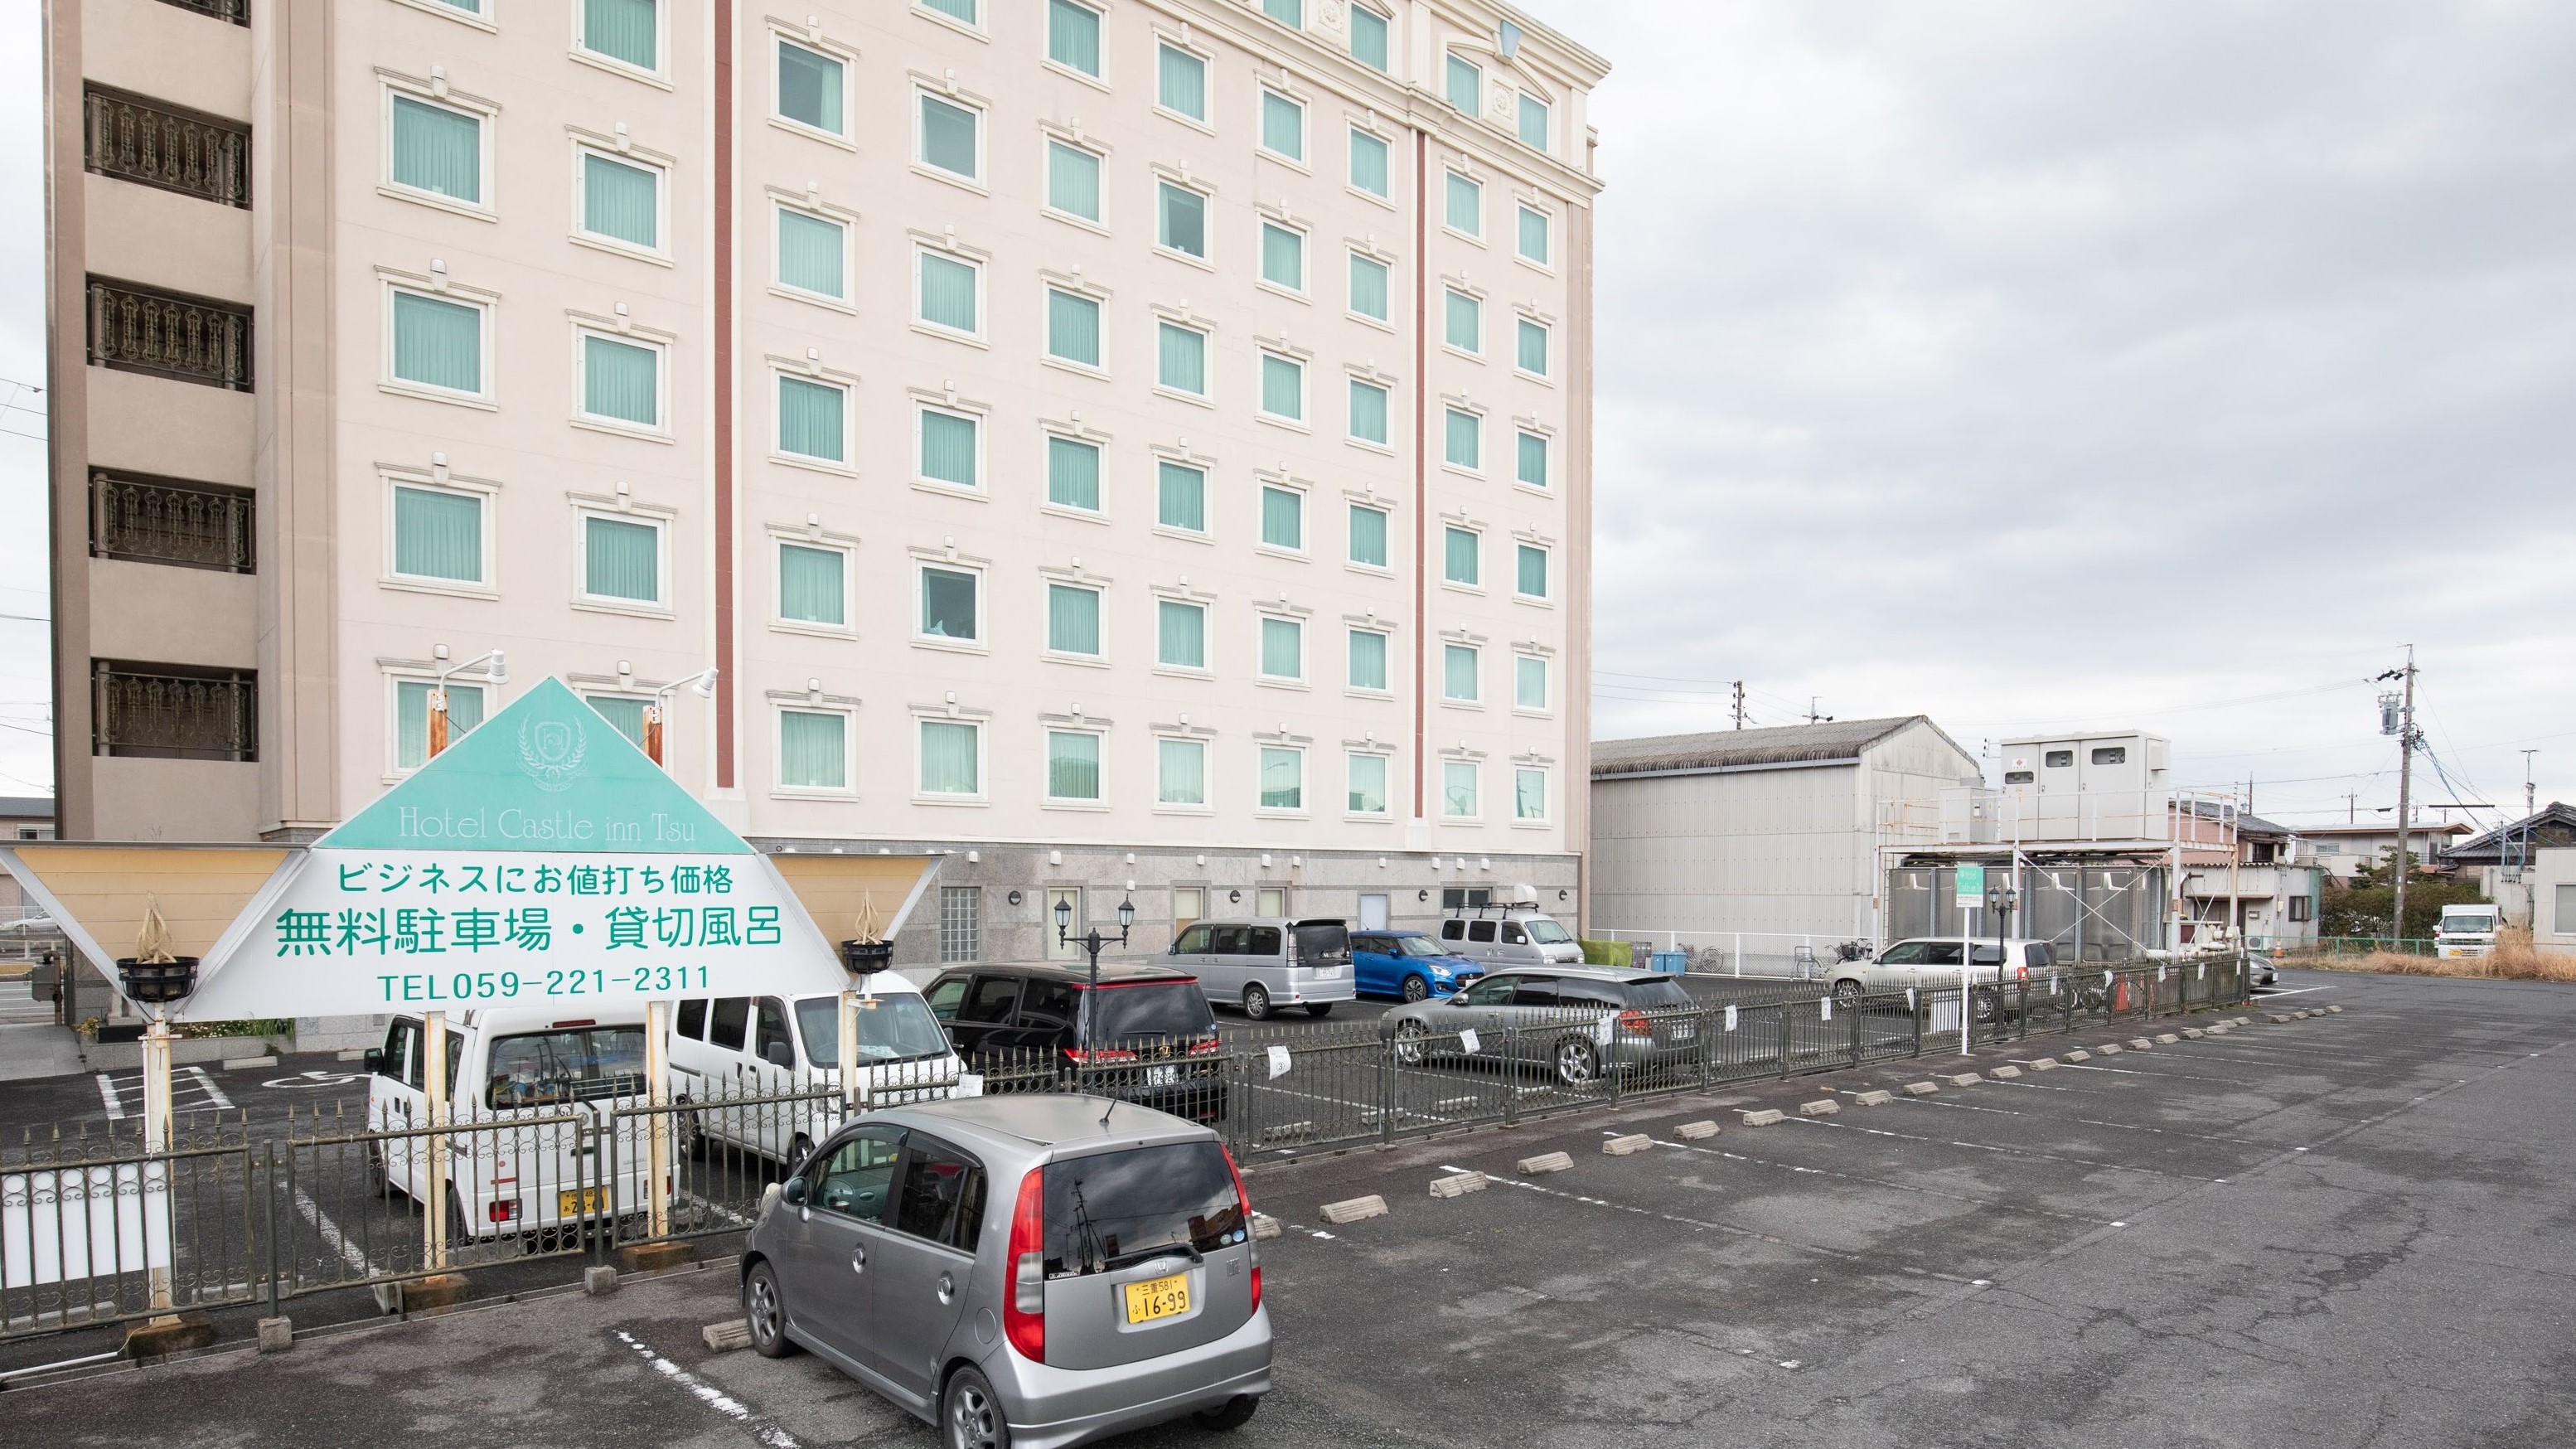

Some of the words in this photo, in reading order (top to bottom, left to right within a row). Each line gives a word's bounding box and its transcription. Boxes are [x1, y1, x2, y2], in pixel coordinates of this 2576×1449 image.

[398, 806, 488, 839] Hotel
[498, 808, 594, 841] Castle
[604, 816, 642, 842] inn
[651, 812, 696, 843] Tsu
[339, 862, 734, 895] ビジネスにお値打ち価格
[275, 905, 782, 957] 無料駐車場・貸切風呂
[1144, 1291, 1186, 1316] 16-99
